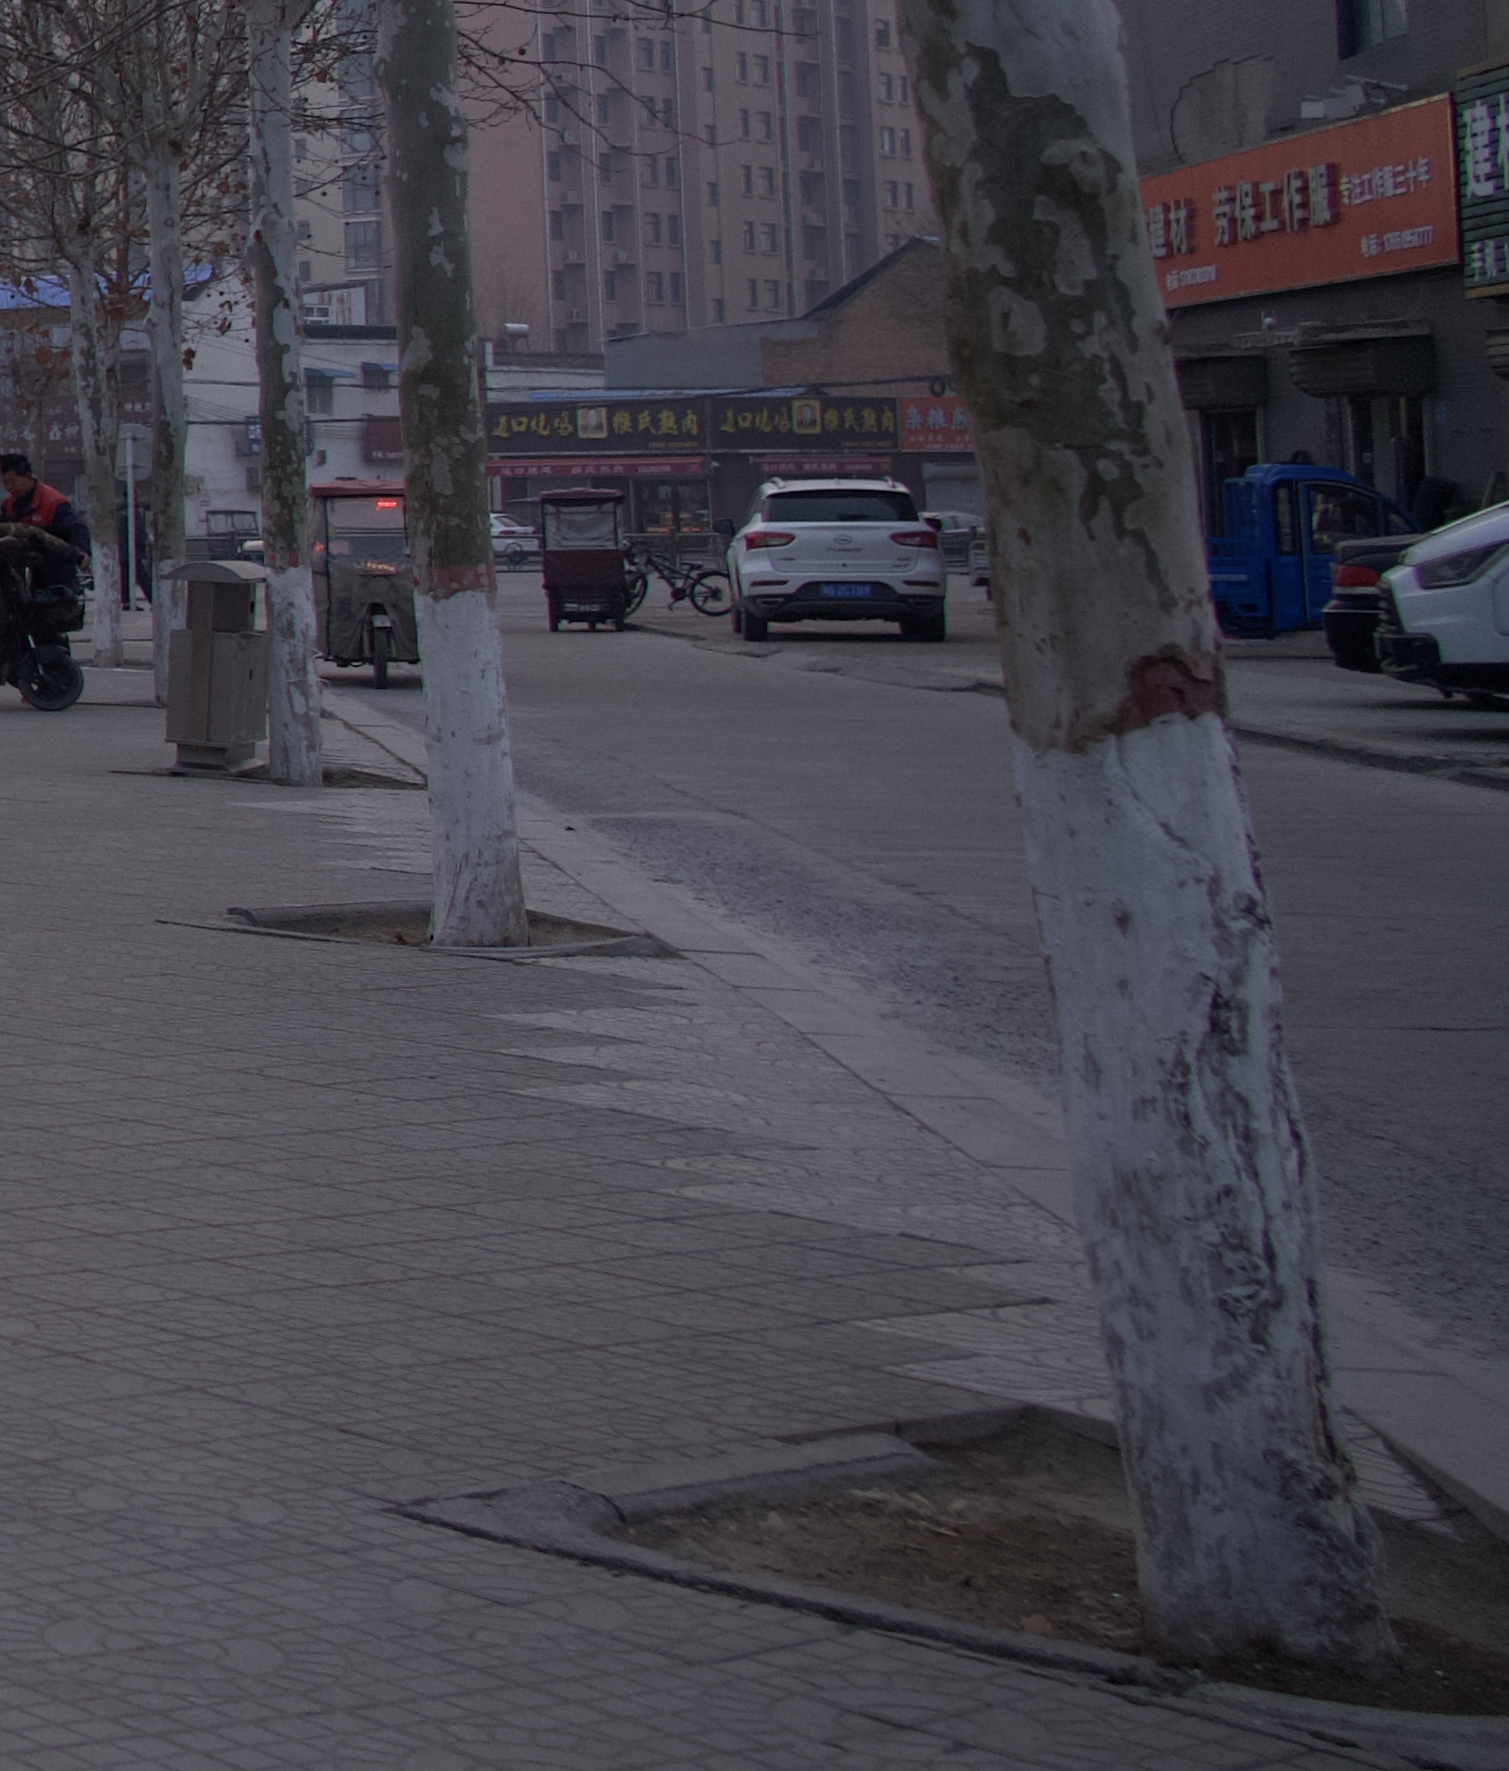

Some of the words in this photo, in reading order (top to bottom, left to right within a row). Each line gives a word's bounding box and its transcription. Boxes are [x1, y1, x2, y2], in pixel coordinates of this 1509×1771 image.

[1212, 163, 1333, 248] 劳保工作服
